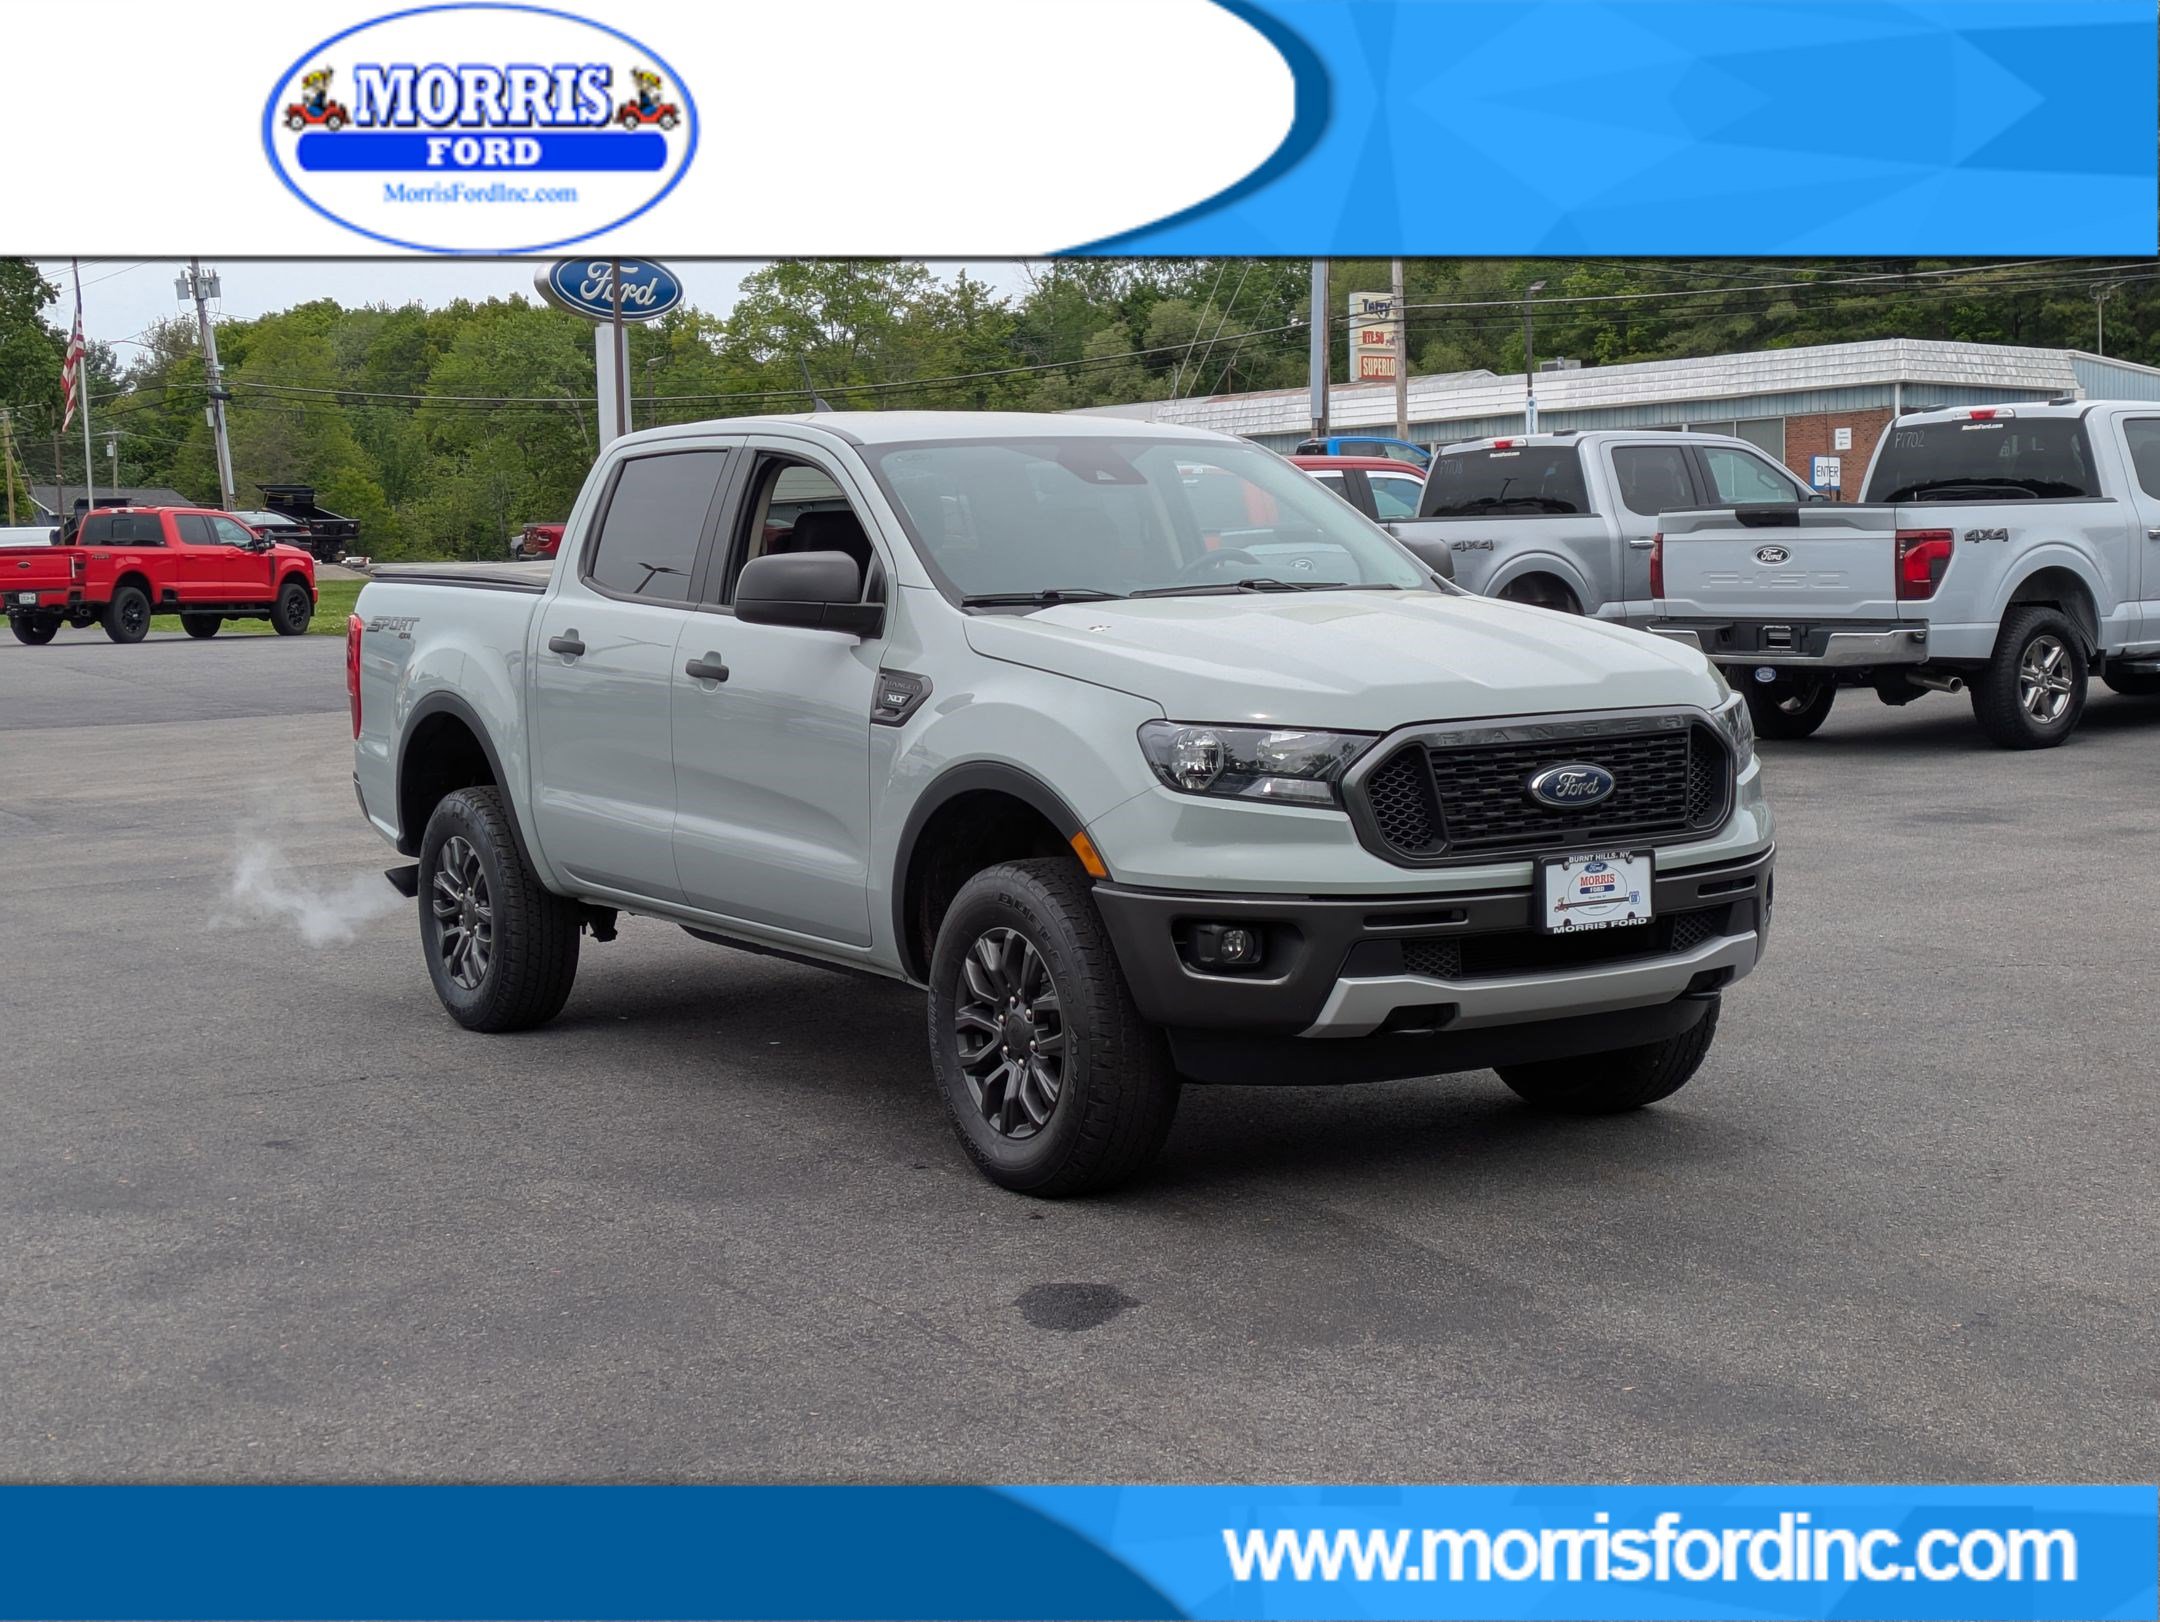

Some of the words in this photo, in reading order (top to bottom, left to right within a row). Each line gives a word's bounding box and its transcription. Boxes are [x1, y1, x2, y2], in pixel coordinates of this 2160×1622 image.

[579, 261, 659, 306] Ford
[1815, 465, 1839, 478] ENTER
[1760, 549, 1784, 561] Ford
[1700, 570, 1850, 589] F-150
[365, 615, 421, 633] SPORT
[886, 693, 906, 703] XLT
[1438, 714, 1685, 746] RANGER
[1555, 771, 1601, 797] Ford
[1568, 854, 1594, 864] BURNT
[1579, 873, 1615, 887] MORRIS
[1553, 922, 1607, 935] MORRIS
[1610, 917, 1648, 928] FORD
